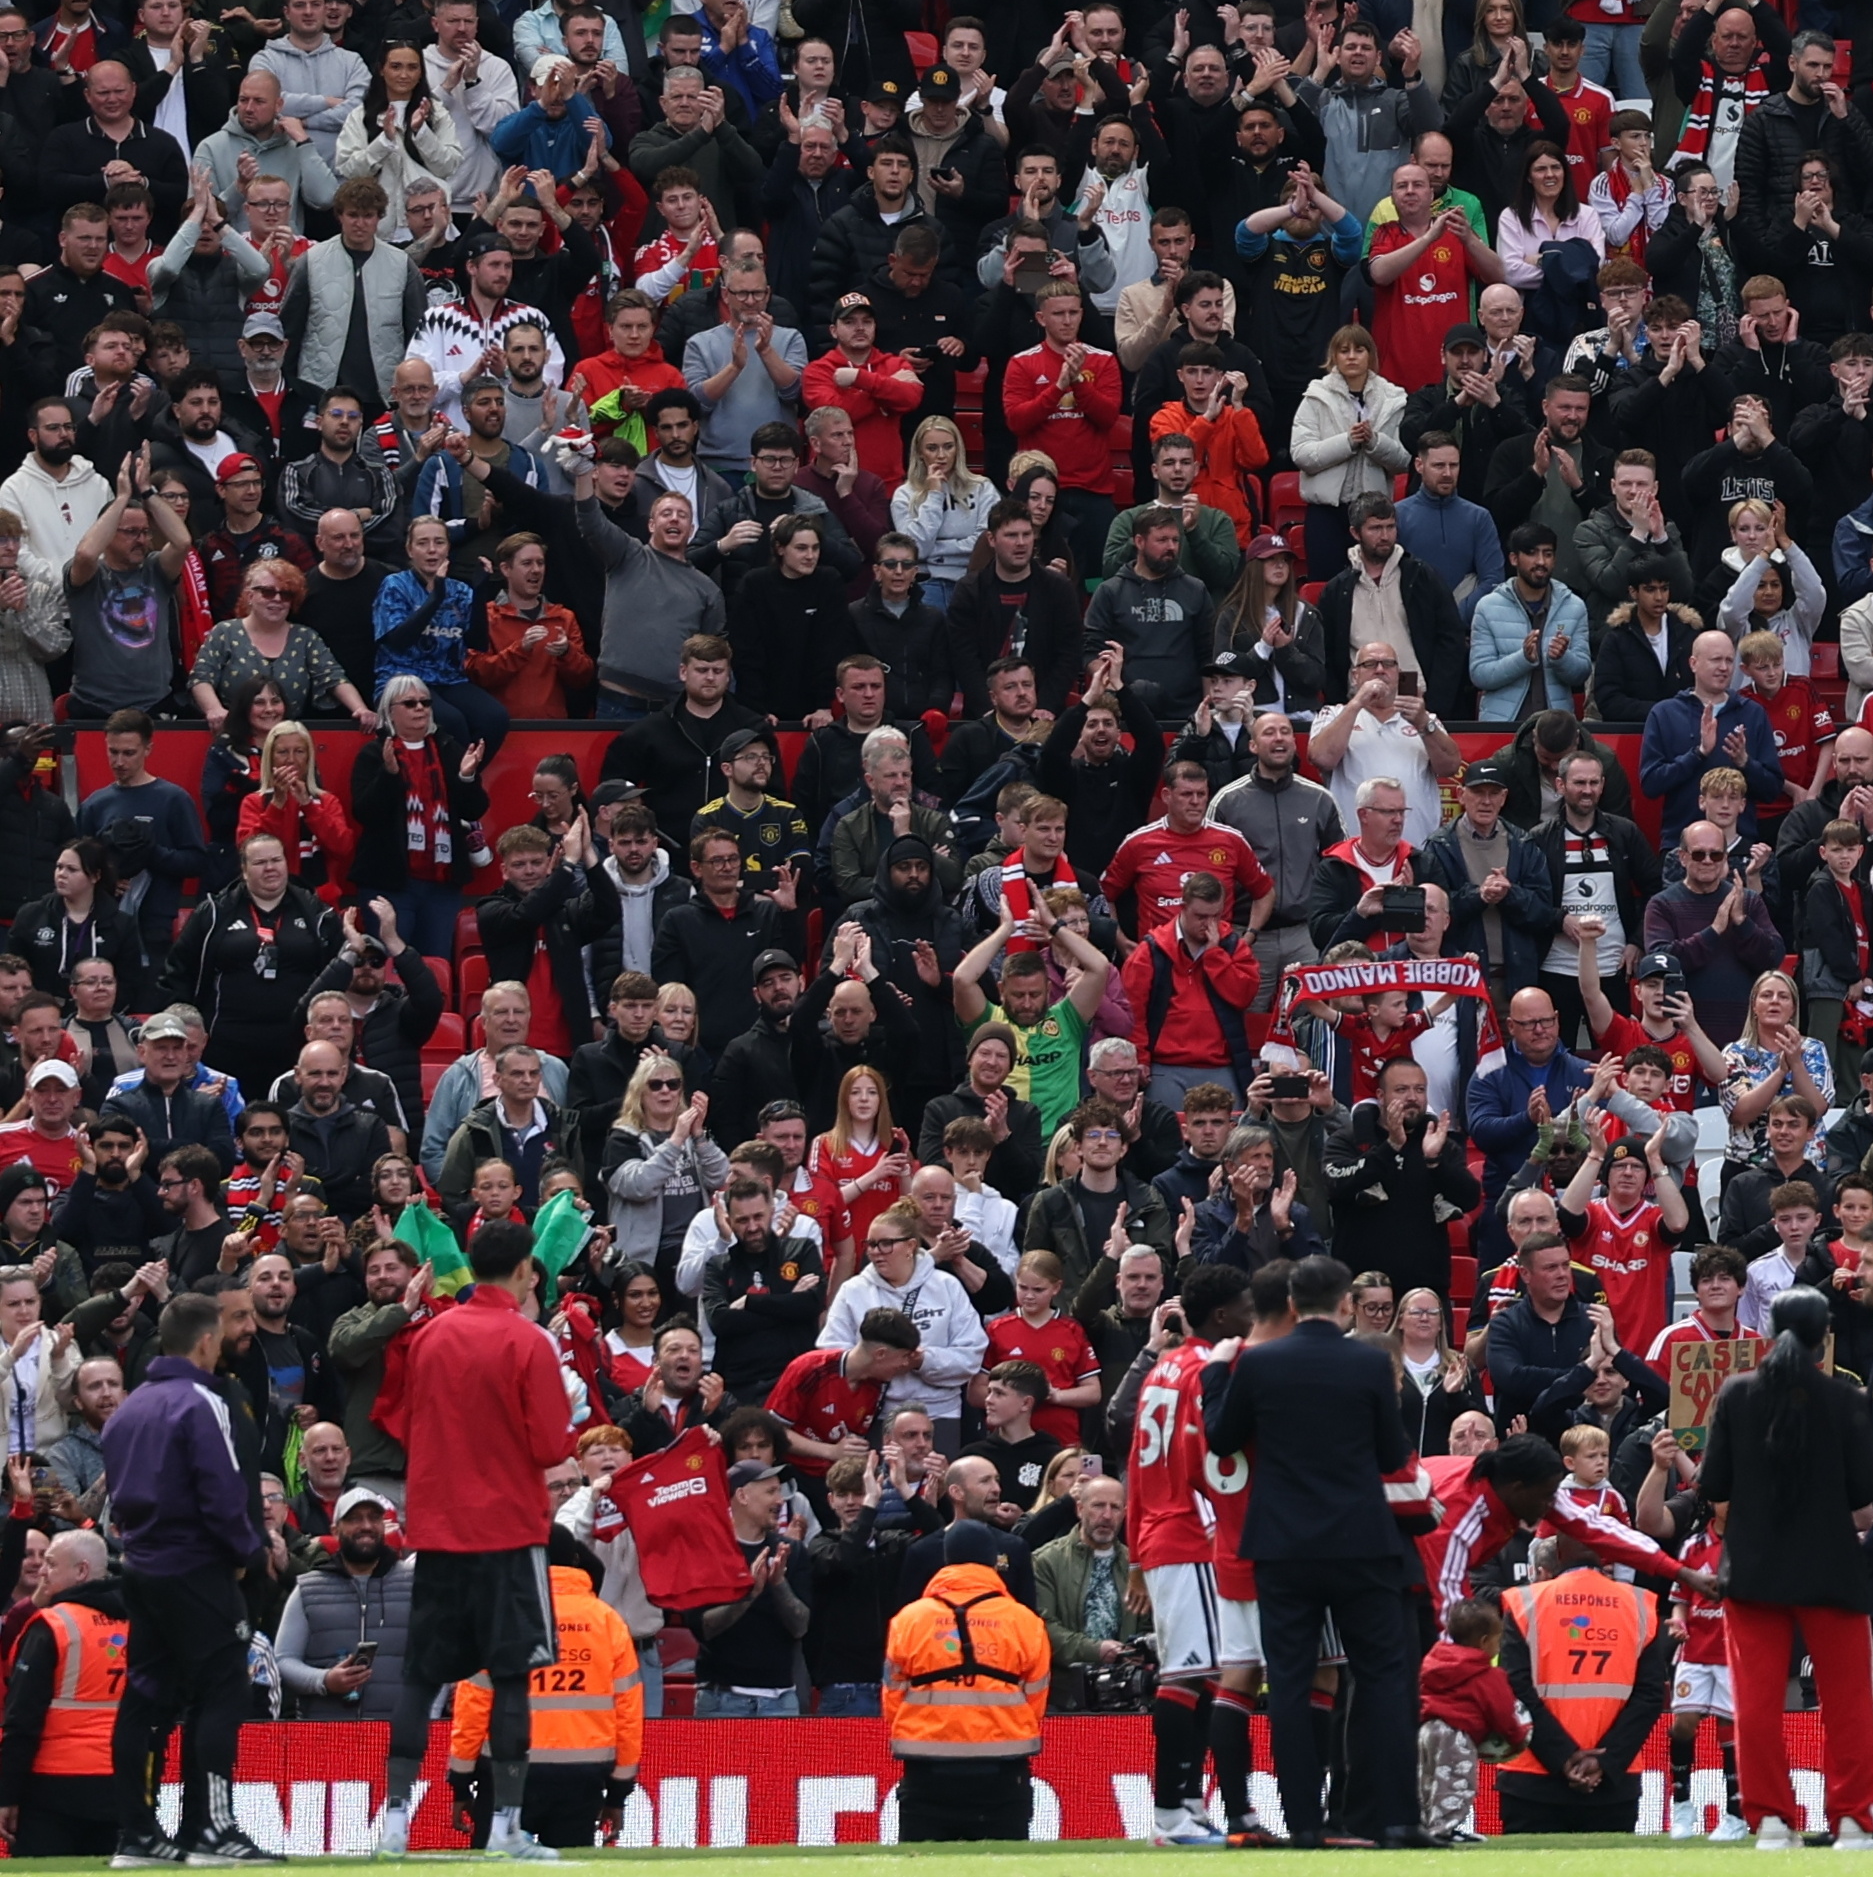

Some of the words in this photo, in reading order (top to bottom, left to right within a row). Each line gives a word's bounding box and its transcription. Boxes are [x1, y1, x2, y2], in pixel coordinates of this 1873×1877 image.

[1104, 209, 1142, 226] Tezos
[1280, 272, 1321, 284] SHARP
[1273, 280, 1327, 294] VIEWCAM
[1404, 289, 1458, 307] Snapdragon
[1146, 596, 1160, 606] THE
[1131, 605, 1162, 614] NORTH
[1140, 613, 1162, 622] FACE
[1776, 744, 1806, 758] dragon
[1562, 901, 1617, 915] napdragon
[1304, 962, 1400, 994] MAINOO
[1403, 959, 1483, 989] KOBBIE
[1013, 1051, 1062, 1067] HARP
[838, 1177, 893, 1192] SARP
[1590, 1254, 1648, 1272] SHARP
[655, 1478, 691, 1496] Team
[647, 1488, 691, 1509] Viewer
[1554, 1593, 1620, 1610] RESPONSE
[1692, 1605, 1725, 1619] Snapd
[558, 1622, 592, 1633] ONSE
[935, 1616, 1001, 1628] RESONSE
[1583, 1626, 1620, 1643] CSG
[1567, 1647, 1609, 1675] 77
[530, 1667, 586, 1693] 122
